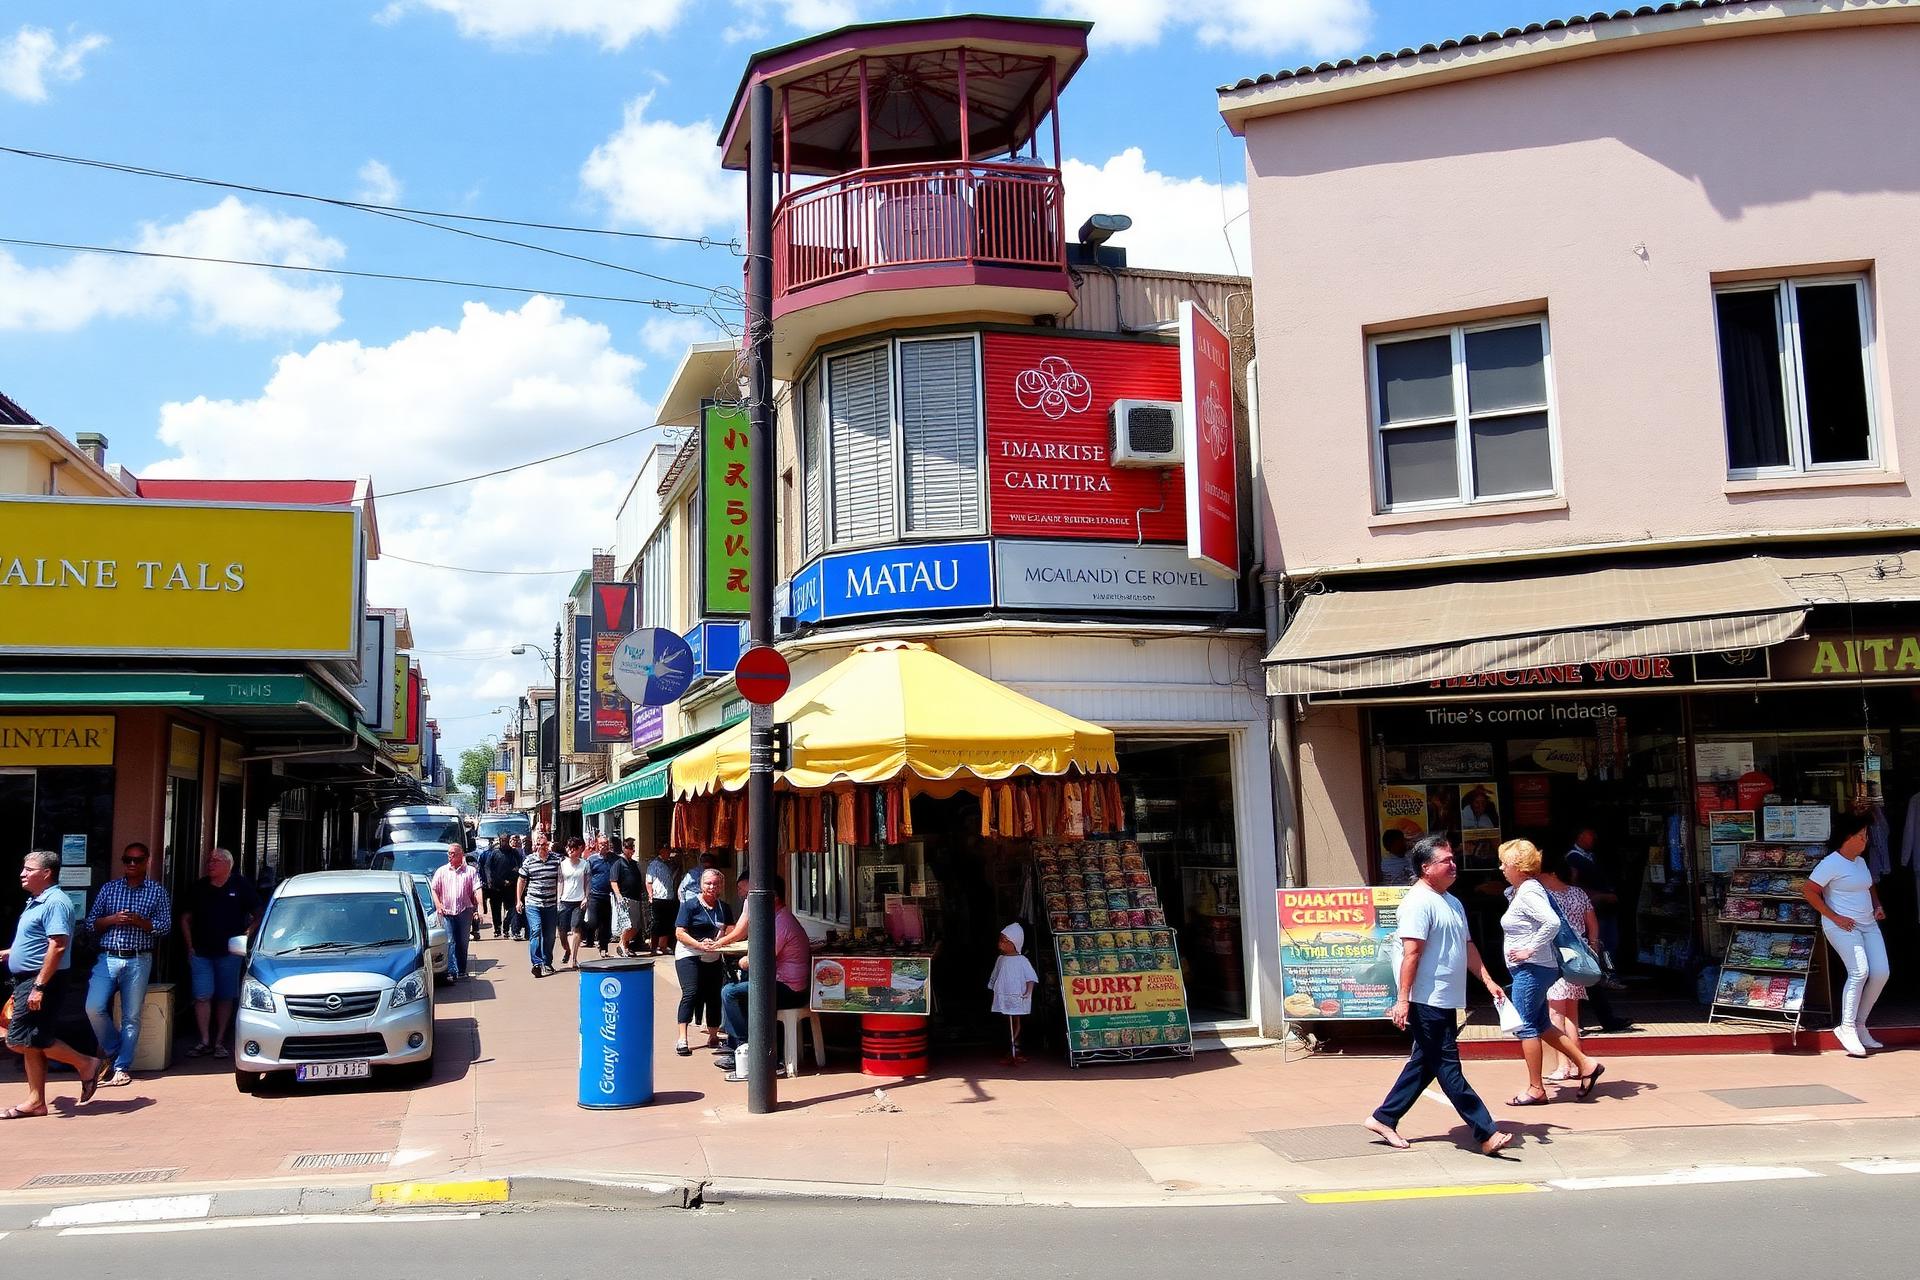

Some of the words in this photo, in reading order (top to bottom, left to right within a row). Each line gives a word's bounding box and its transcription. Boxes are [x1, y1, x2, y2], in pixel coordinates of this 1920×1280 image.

[1005, 471, 1111, 492] CARITIRA
[0, 557, 118, 589] ALNE
[137, 561, 246, 592] TALS
[846, 559, 958, 598] MATAU
[1125, 569, 1147, 585] CE
[1591, 655, 1675, 682] YOUR
